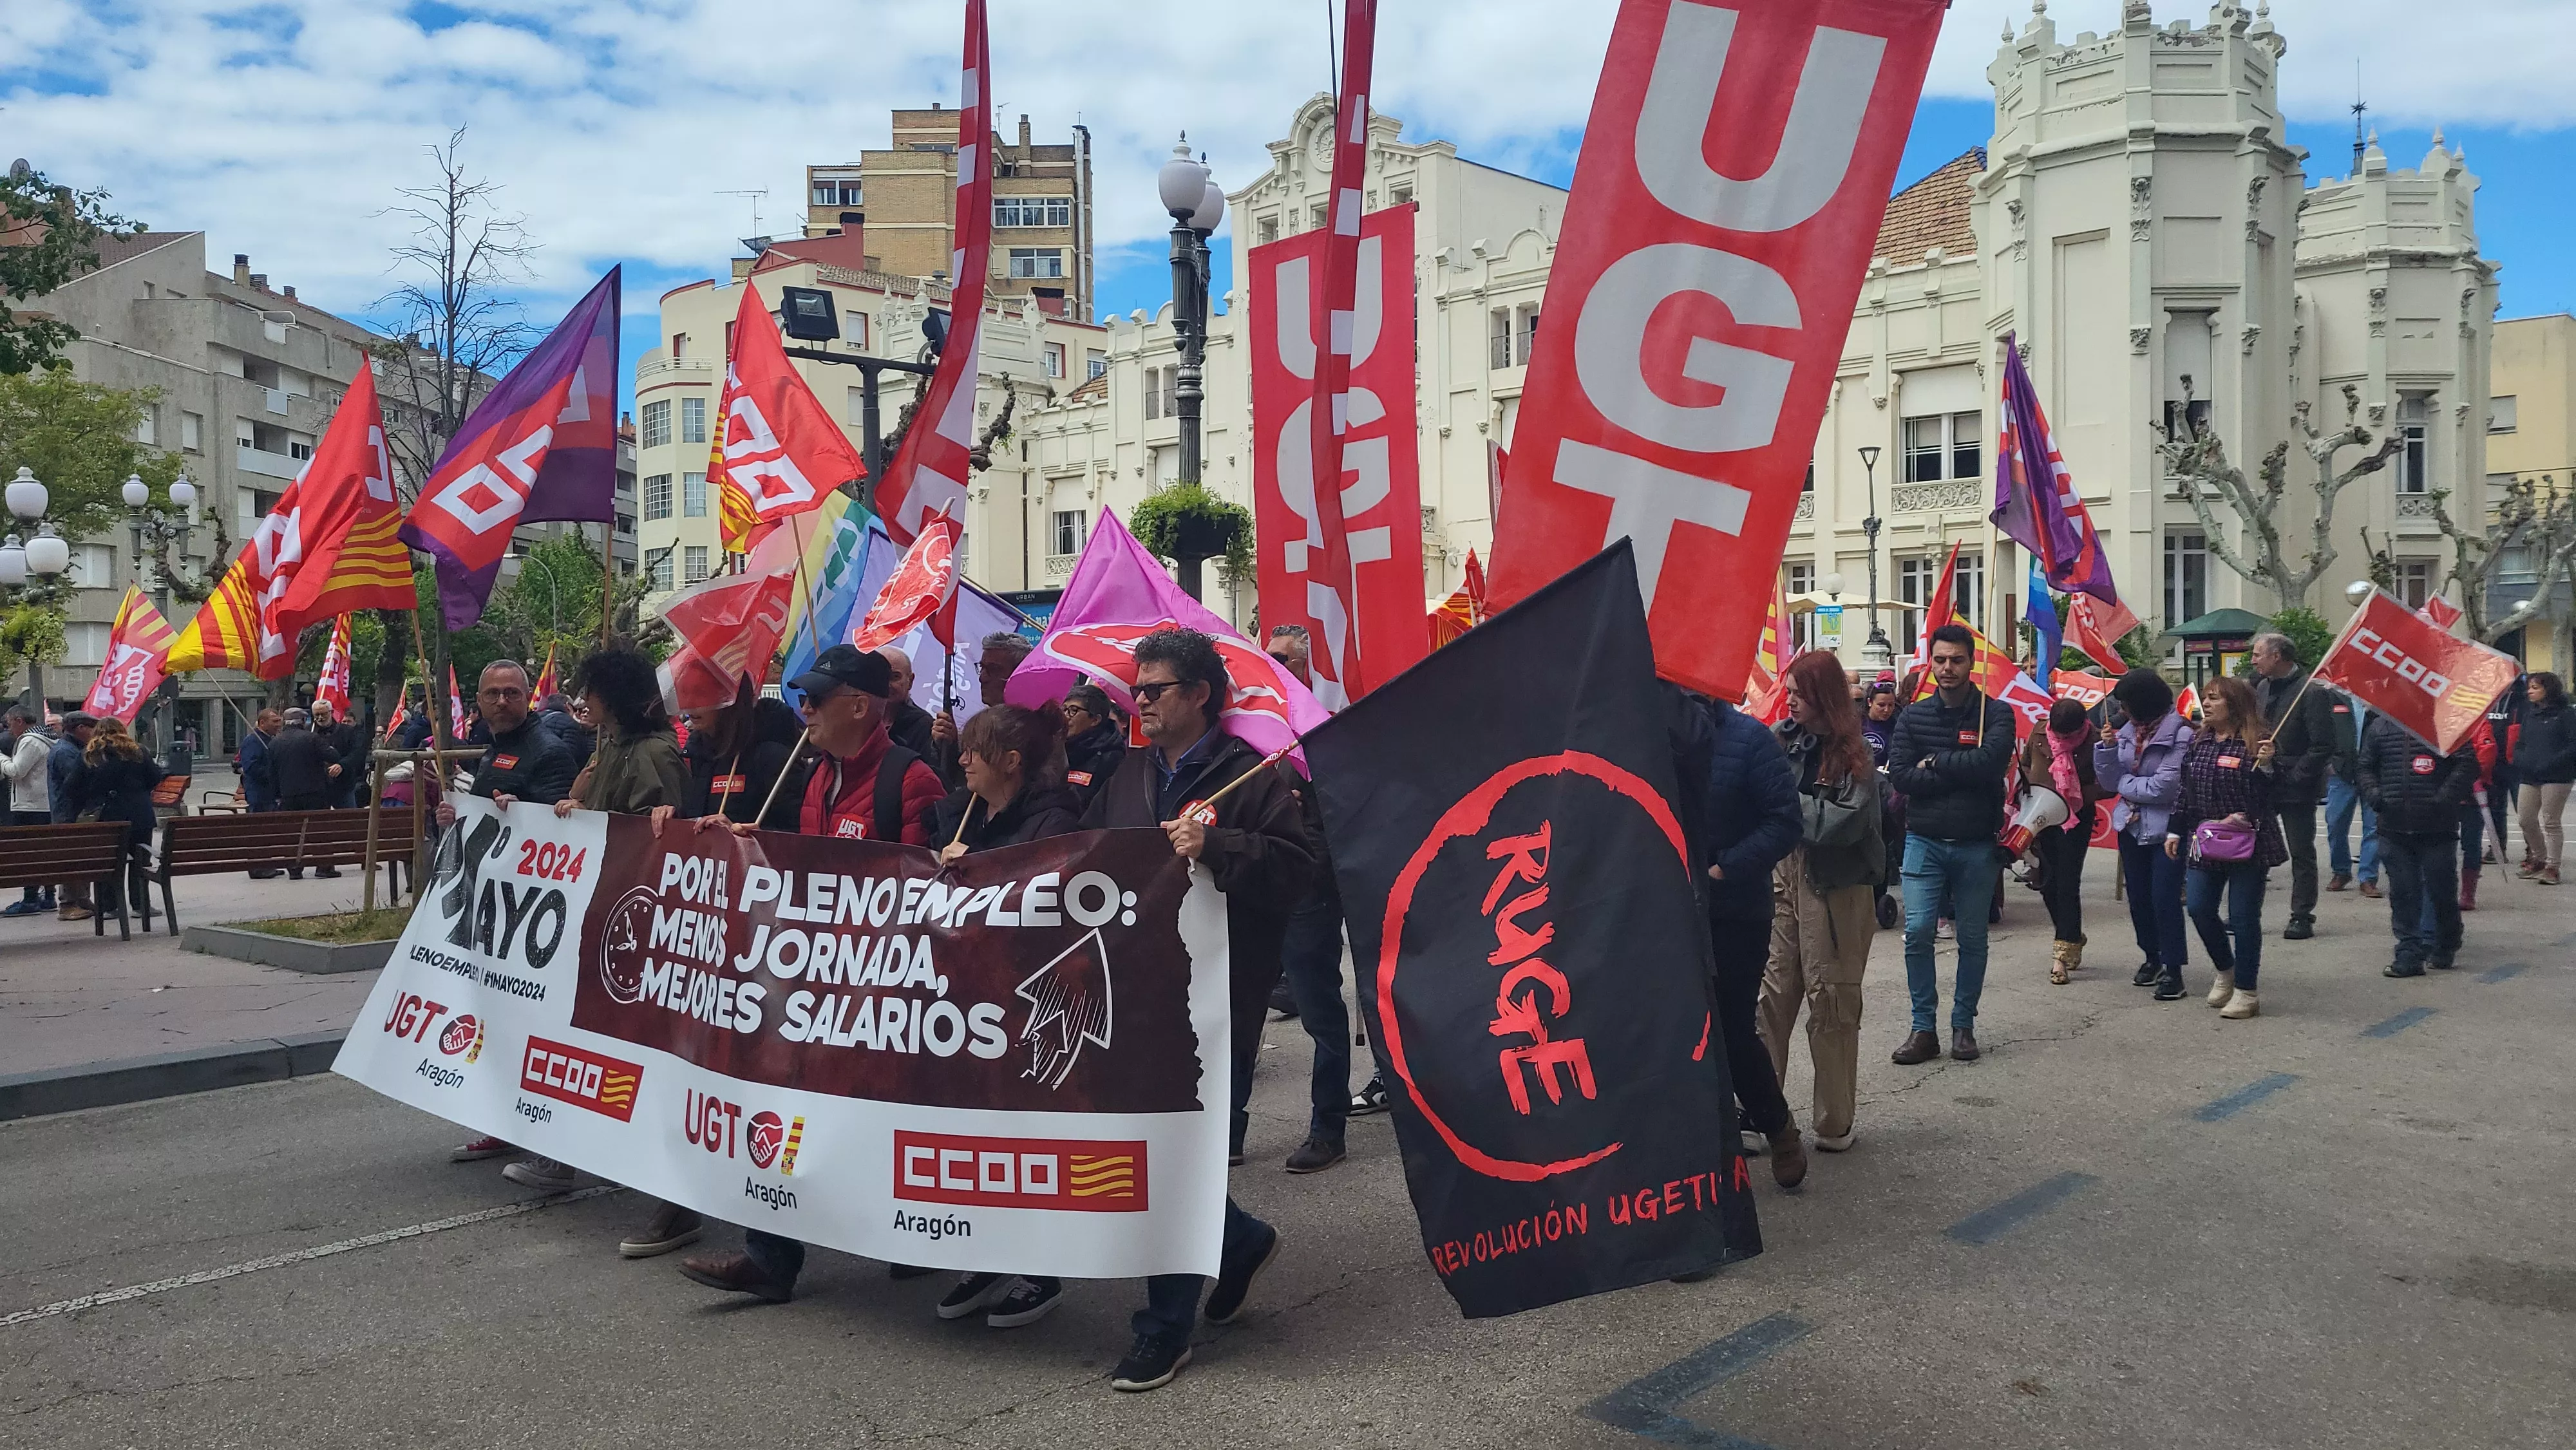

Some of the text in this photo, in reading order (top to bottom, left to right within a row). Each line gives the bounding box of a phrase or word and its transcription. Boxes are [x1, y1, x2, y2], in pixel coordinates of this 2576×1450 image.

[1551, 0, 1888, 628] UGT
[2349, 627, 2451, 697] CCOO
[838, 818, 864, 839] UGT
[517, 838, 587, 883] 2024
[658, 852, 1137, 928] POR EL PLENO EMPLEO:
[649, 905, 949, 997] MENOS JORNADA,
[1482, 818, 1597, 1116] RUGE
[484, 970, 547, 1002] #1MAYO2024
[638, 957, 1008, 1059] MEJORES SALARIOS
[384, 989, 449, 1043] UGT
[415, 1057, 464, 1089] Aragón
[526, 1048, 603, 1100] CCOO
[515, 1097, 552, 1124] Aragón
[685, 1088, 742, 1159] UGT
[744, 1176, 797, 1210] Aragón
[904, 1145, 1058, 1196] CCOO
[893, 1209, 972, 1241] Aragón
[1432, 1155, 1751, 1276] REVOLUCIÓN UGETIA
